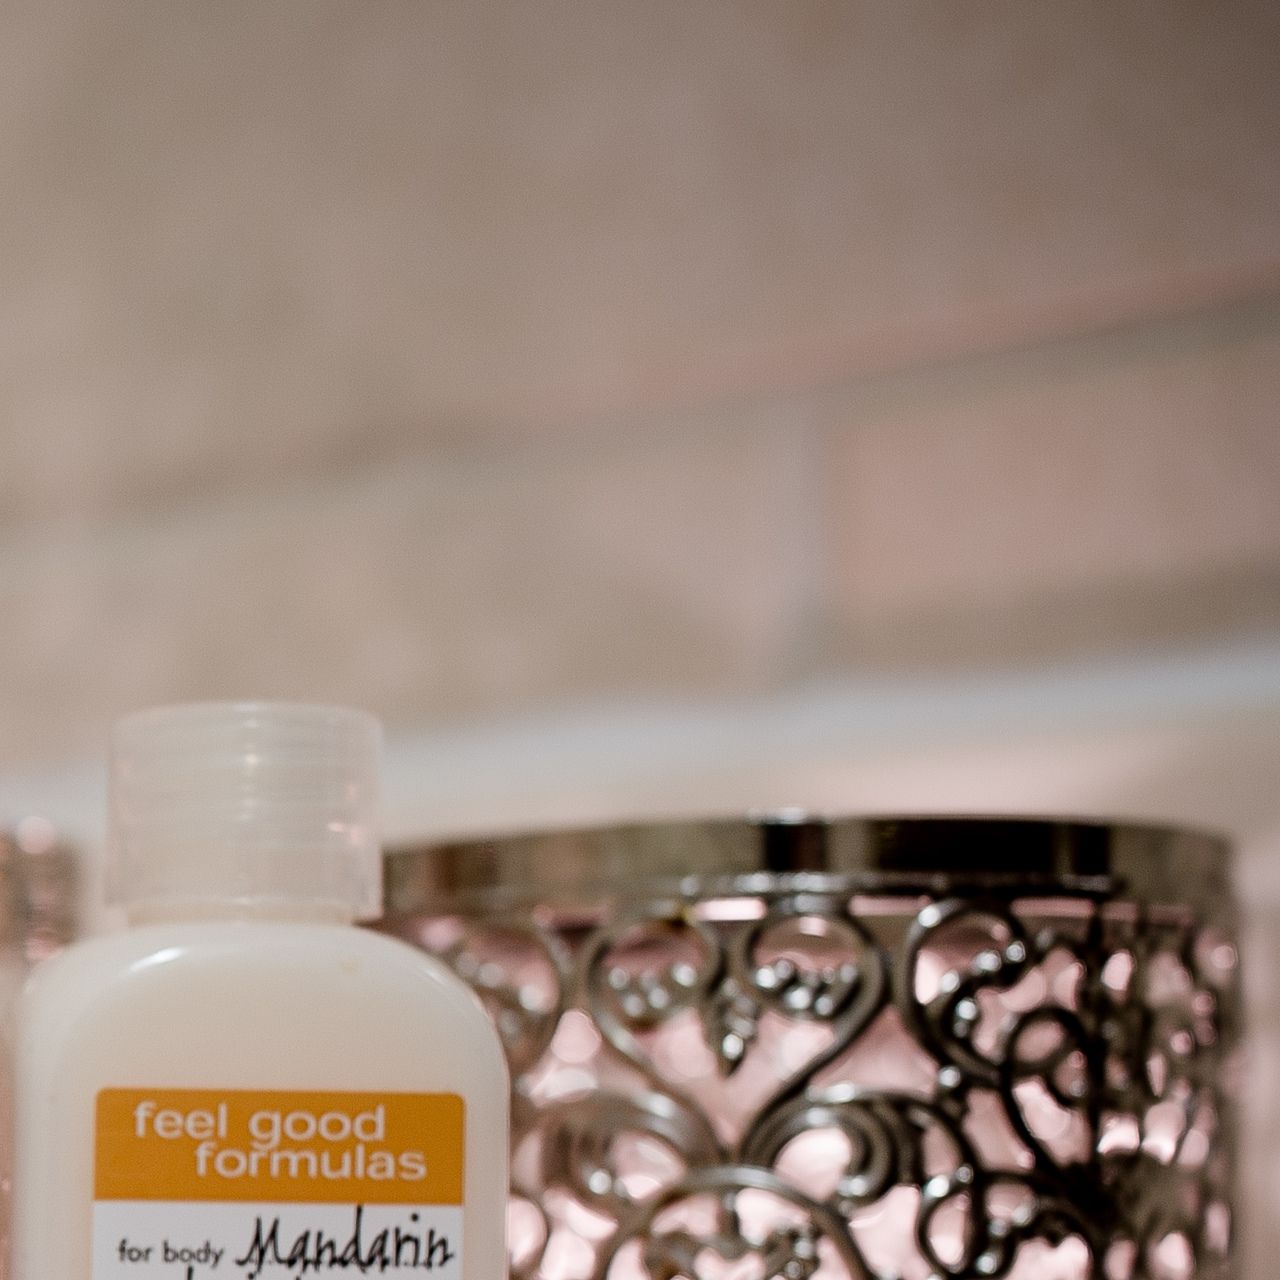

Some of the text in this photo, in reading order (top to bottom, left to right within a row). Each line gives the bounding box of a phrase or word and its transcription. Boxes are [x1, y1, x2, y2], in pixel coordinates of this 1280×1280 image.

[133, 1101, 385, 1151] feel good
[195, 1141, 427, 1182] formulas
[118, 1203, 455, 1272] for body Mandarin
